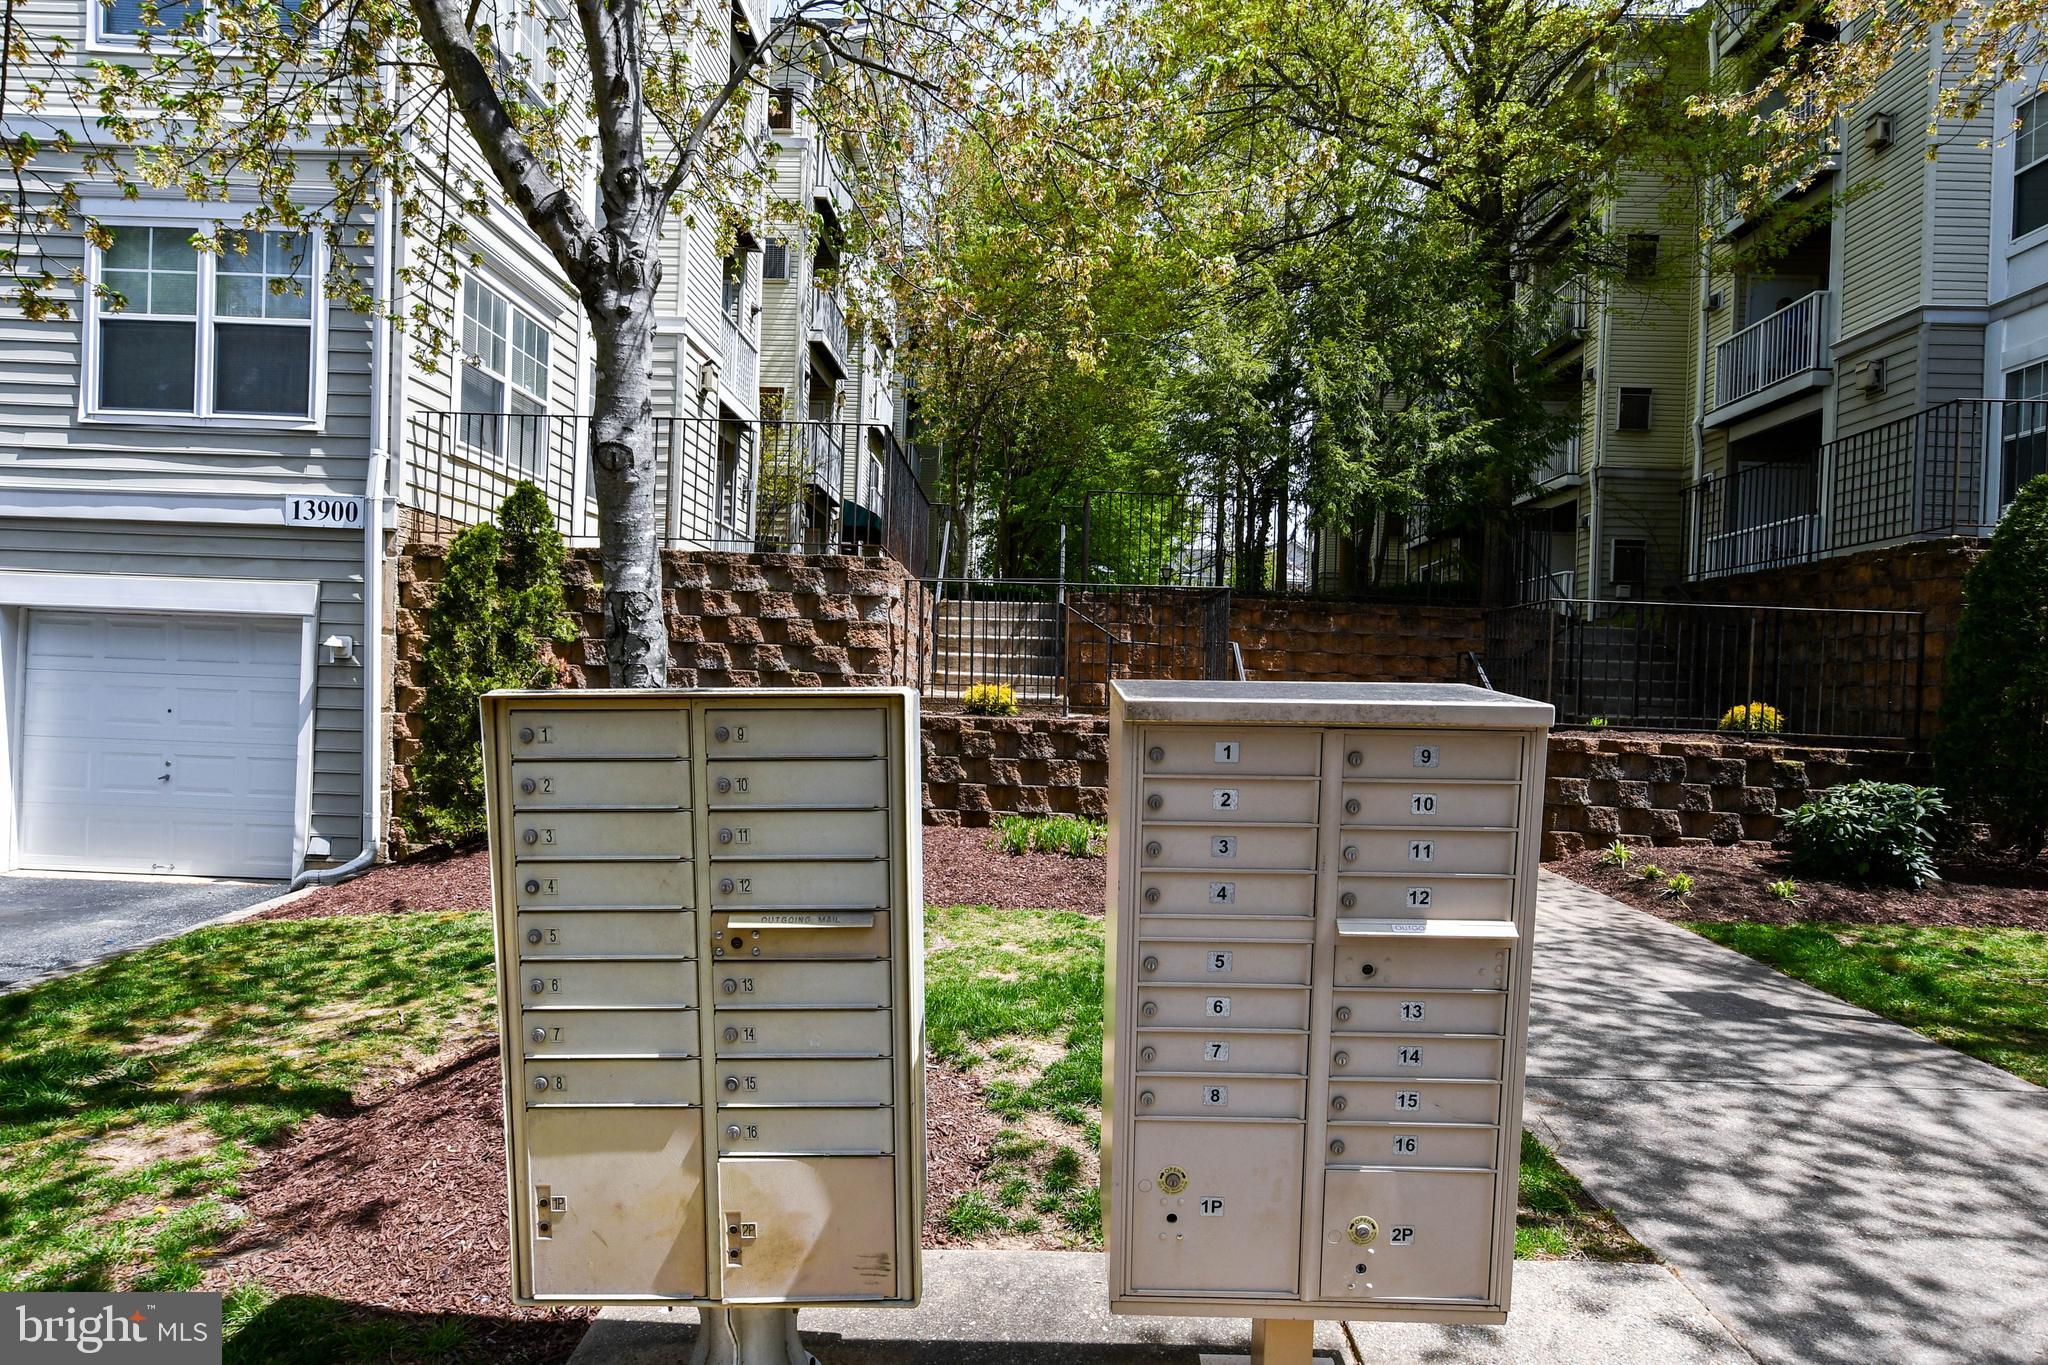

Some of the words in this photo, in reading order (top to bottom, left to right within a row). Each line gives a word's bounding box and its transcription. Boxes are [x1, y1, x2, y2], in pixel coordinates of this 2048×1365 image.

[292, 499, 359, 523] 13900
[542, 728, 548, 741] 1
[738, 727, 744, 740] 9
[1223, 745, 1232, 760] 1
[1421, 749, 1431, 763] 9
[543, 779, 551, 792] 2
[737, 778, 748, 791] 10
[1221, 792, 1231, 807] 2
[1413, 797, 1434, 812] 10
[546, 829, 553, 842] 3
[738, 828, 748, 841] 11
[1219, 840, 1229, 854] 3
[1412, 844, 1432, 858] 11
[548, 880, 554, 893] 4
[740, 879, 751, 892] 12
[1217, 886, 1227, 900] 4
[1410, 891, 1429, 905] 12
[550, 929, 557, 942] 5
[1215, 955, 1225, 968] 5
[552, 979, 558, 991] 6
[743, 979, 754, 992] 13
[1213, 999, 1223, 1013] 6
[1402, 1005, 1422, 1018] 13
[554, 1028, 560, 1040] 7
[743, 1028, 754, 1040] 14
[1212, 1045, 1221, 1058] 7
[1400, 1050, 1420, 1063] 14
[556, 1077, 563, 1089] 8
[745, 1077, 756, 1089] 15
[1211, 1089, 1220, 1102] 8
[1398, 1095, 1417, 1108] 15
[747, 1126, 757, 1138] 16
[1396, 1138, 1415, 1151] 16
[552, 1197, 564, 1210] 1P
[1201, 1200, 1223, 1213] 1P
[742, 1223, 755, 1237] 2P
[1392, 1228, 1413, 1242] 2P
